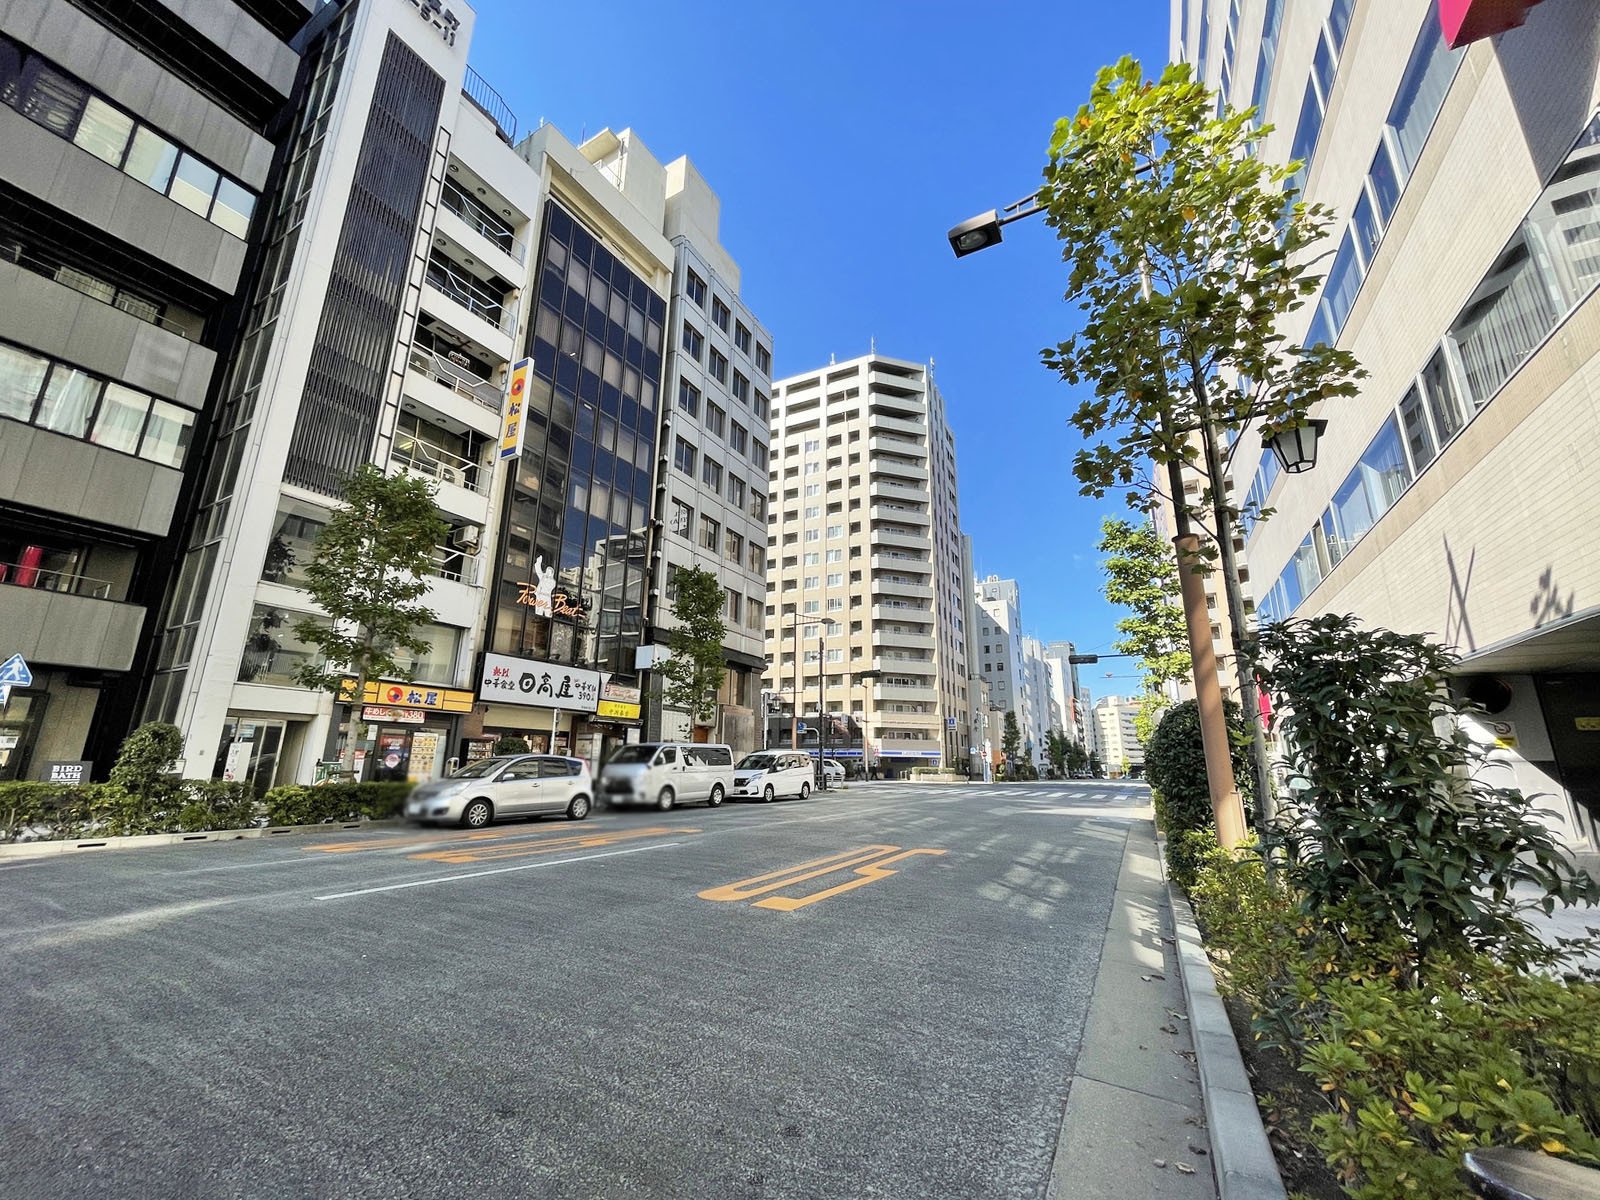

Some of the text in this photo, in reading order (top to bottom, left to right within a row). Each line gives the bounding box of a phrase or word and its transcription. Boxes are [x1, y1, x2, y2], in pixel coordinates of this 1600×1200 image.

[505, 402, 521, 438] 松屋
[552, 593, 588, 618] Beat
[518, 671, 574, 699] 日高屋
[406, 689, 438, 706] 松屋
[365, 707, 386, 716] 牛めし
[52, 764, 83, 773] BIRD
